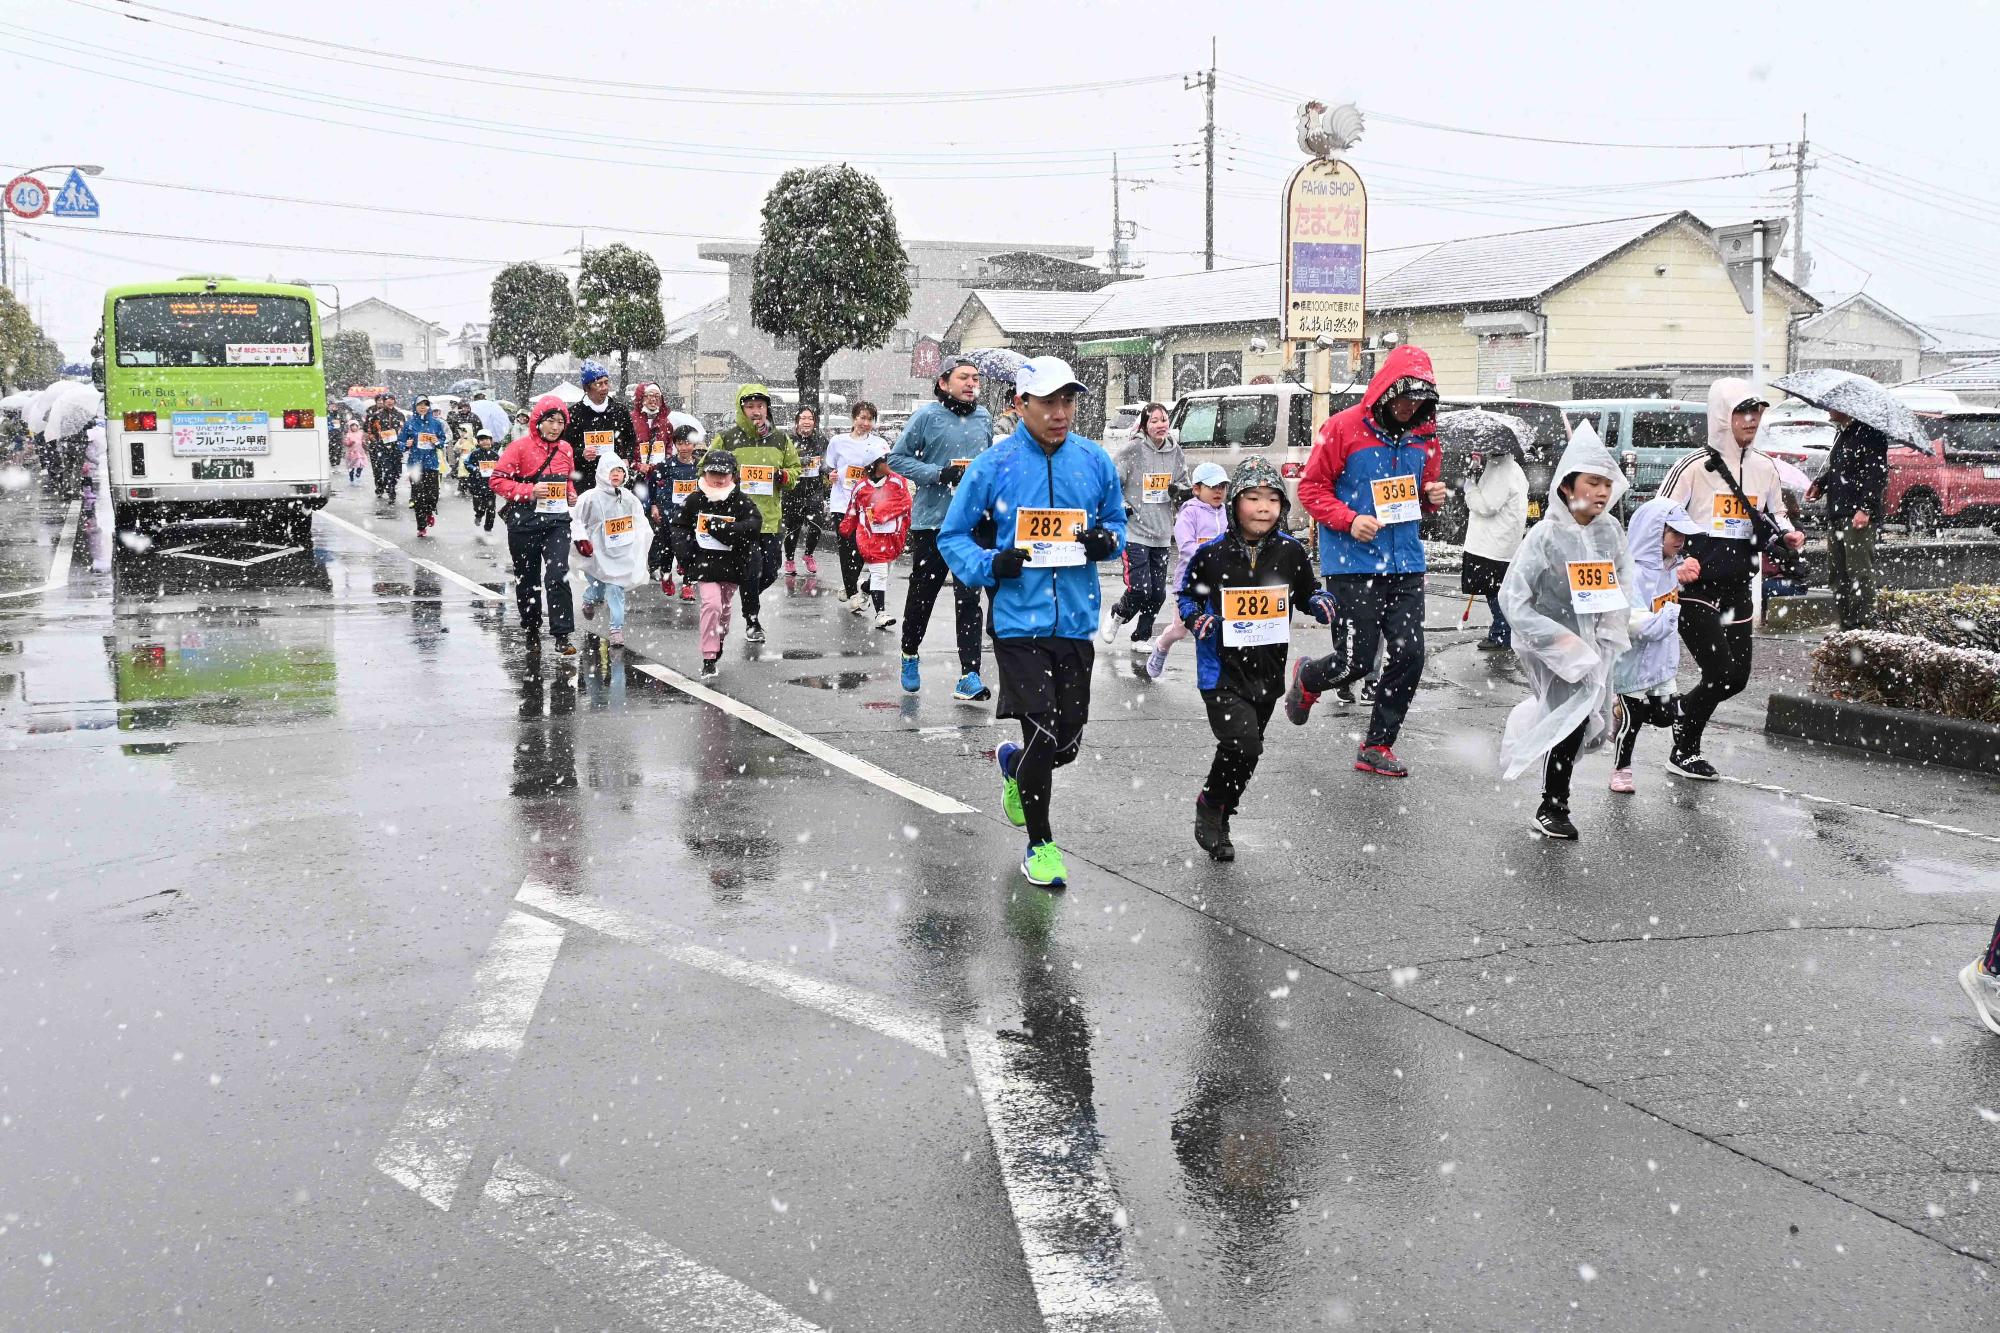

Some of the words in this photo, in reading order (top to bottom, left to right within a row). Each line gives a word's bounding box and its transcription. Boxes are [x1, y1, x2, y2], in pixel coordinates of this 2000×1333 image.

[1301, 180, 1328, 195] FARM
[1329, 181, 1355, 196] SHOP
[16, 188, 40, 207] 40
[1295, 203, 1360, 237] たまご村
[1295, 265, 1357, 289] 黒富士農場
[129, 387, 151, 397] The
[155, 387, 176, 397] Bus
[196, 435, 267, 446] フルリール甲府
[590, 434, 605, 444] 330
[747, 469, 763, 480] 352
[1150, 477, 1165, 488] 377
[1382, 483, 1406, 501] 359
[610, 520, 625, 532] 280
[1030, 516, 1063, 537] 282
[1577, 568, 1602, 586] 359
[1236, 595, 1269, 616] 282
[1278, 600, 1285, 610] B
[1255, 622, 1281, 631] メイコー
